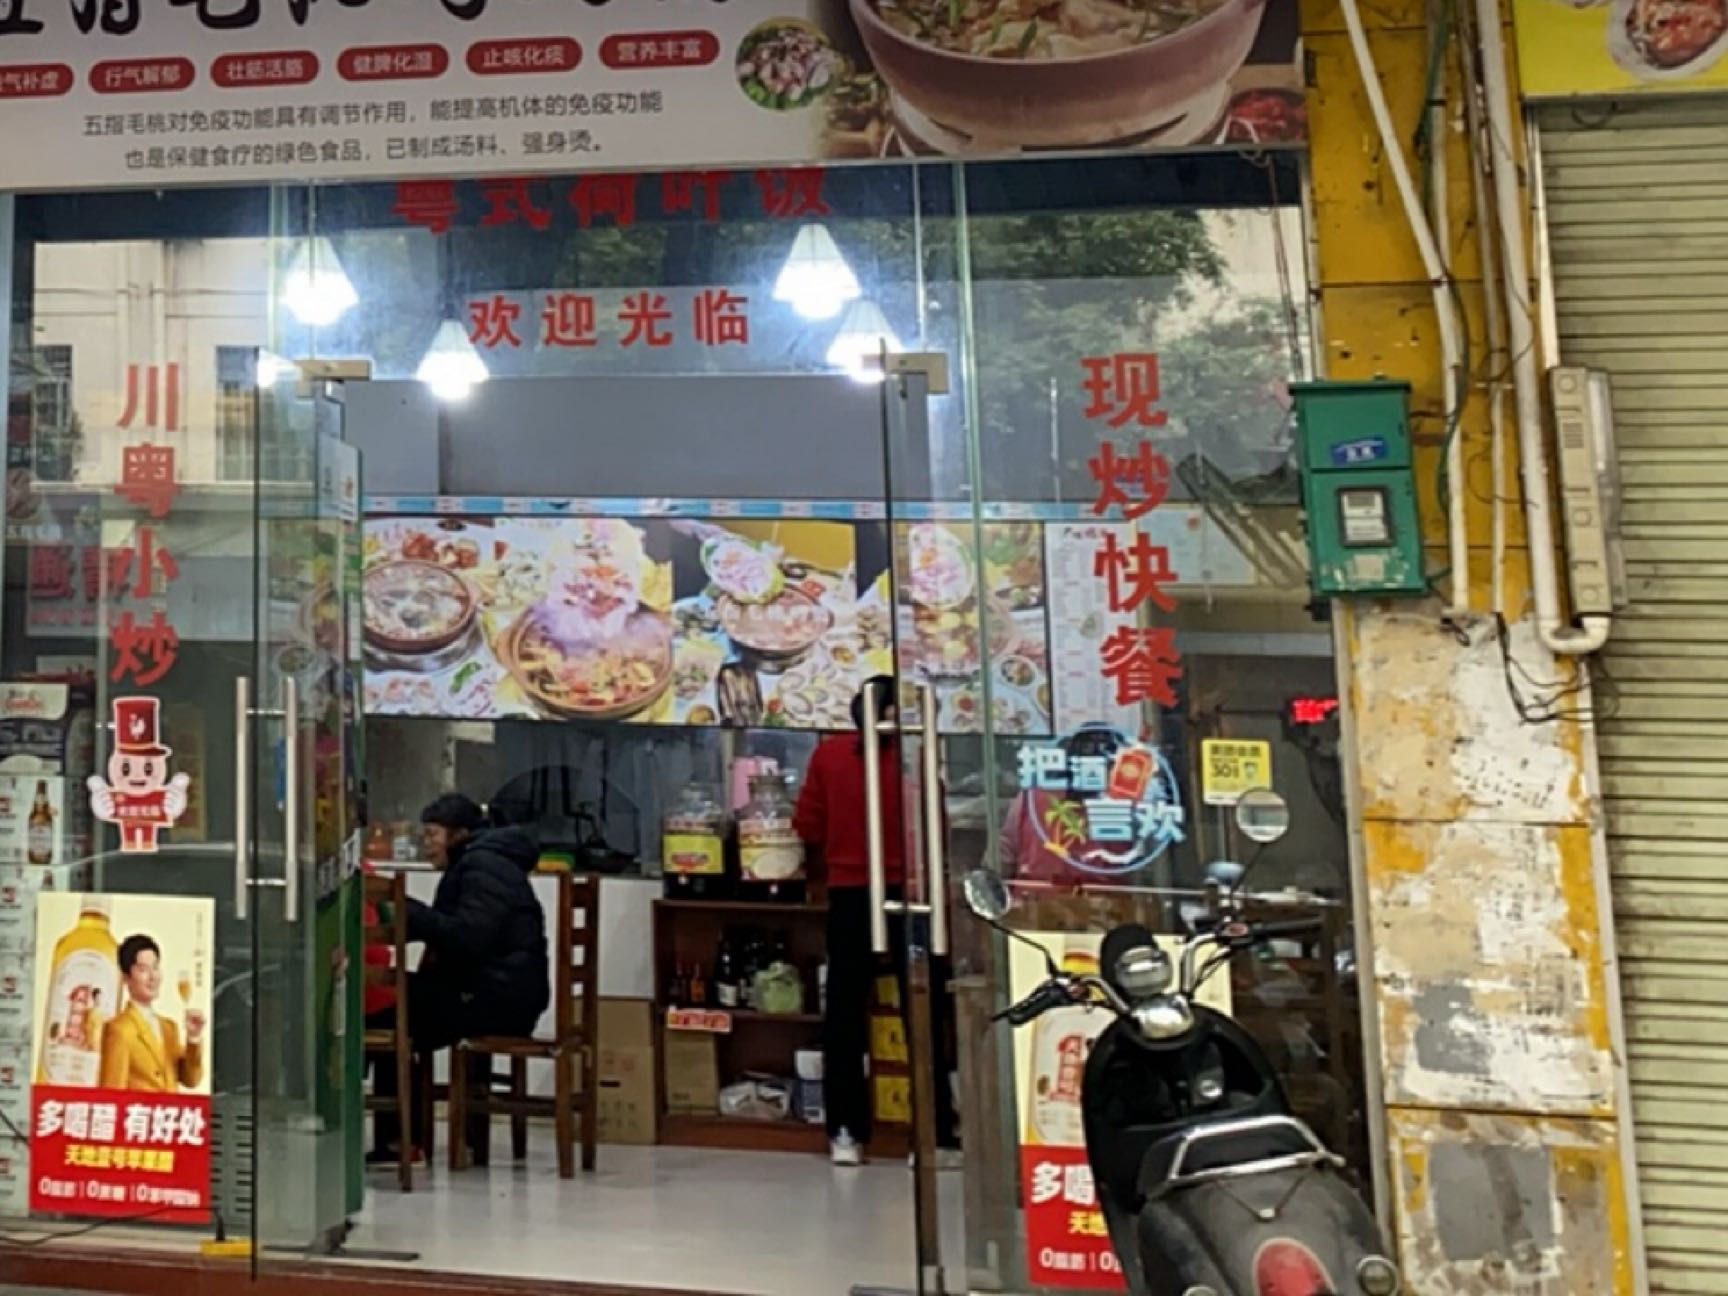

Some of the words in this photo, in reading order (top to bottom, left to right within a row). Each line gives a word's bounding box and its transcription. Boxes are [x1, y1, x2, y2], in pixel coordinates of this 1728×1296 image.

[468, 290, 750, 349] 欢迎光临
[109, 361, 184, 687] 川粤小炒
[1079, 351, 1184, 707] 现炒快餐
[124, 1103, 206, 1146] 有好处
